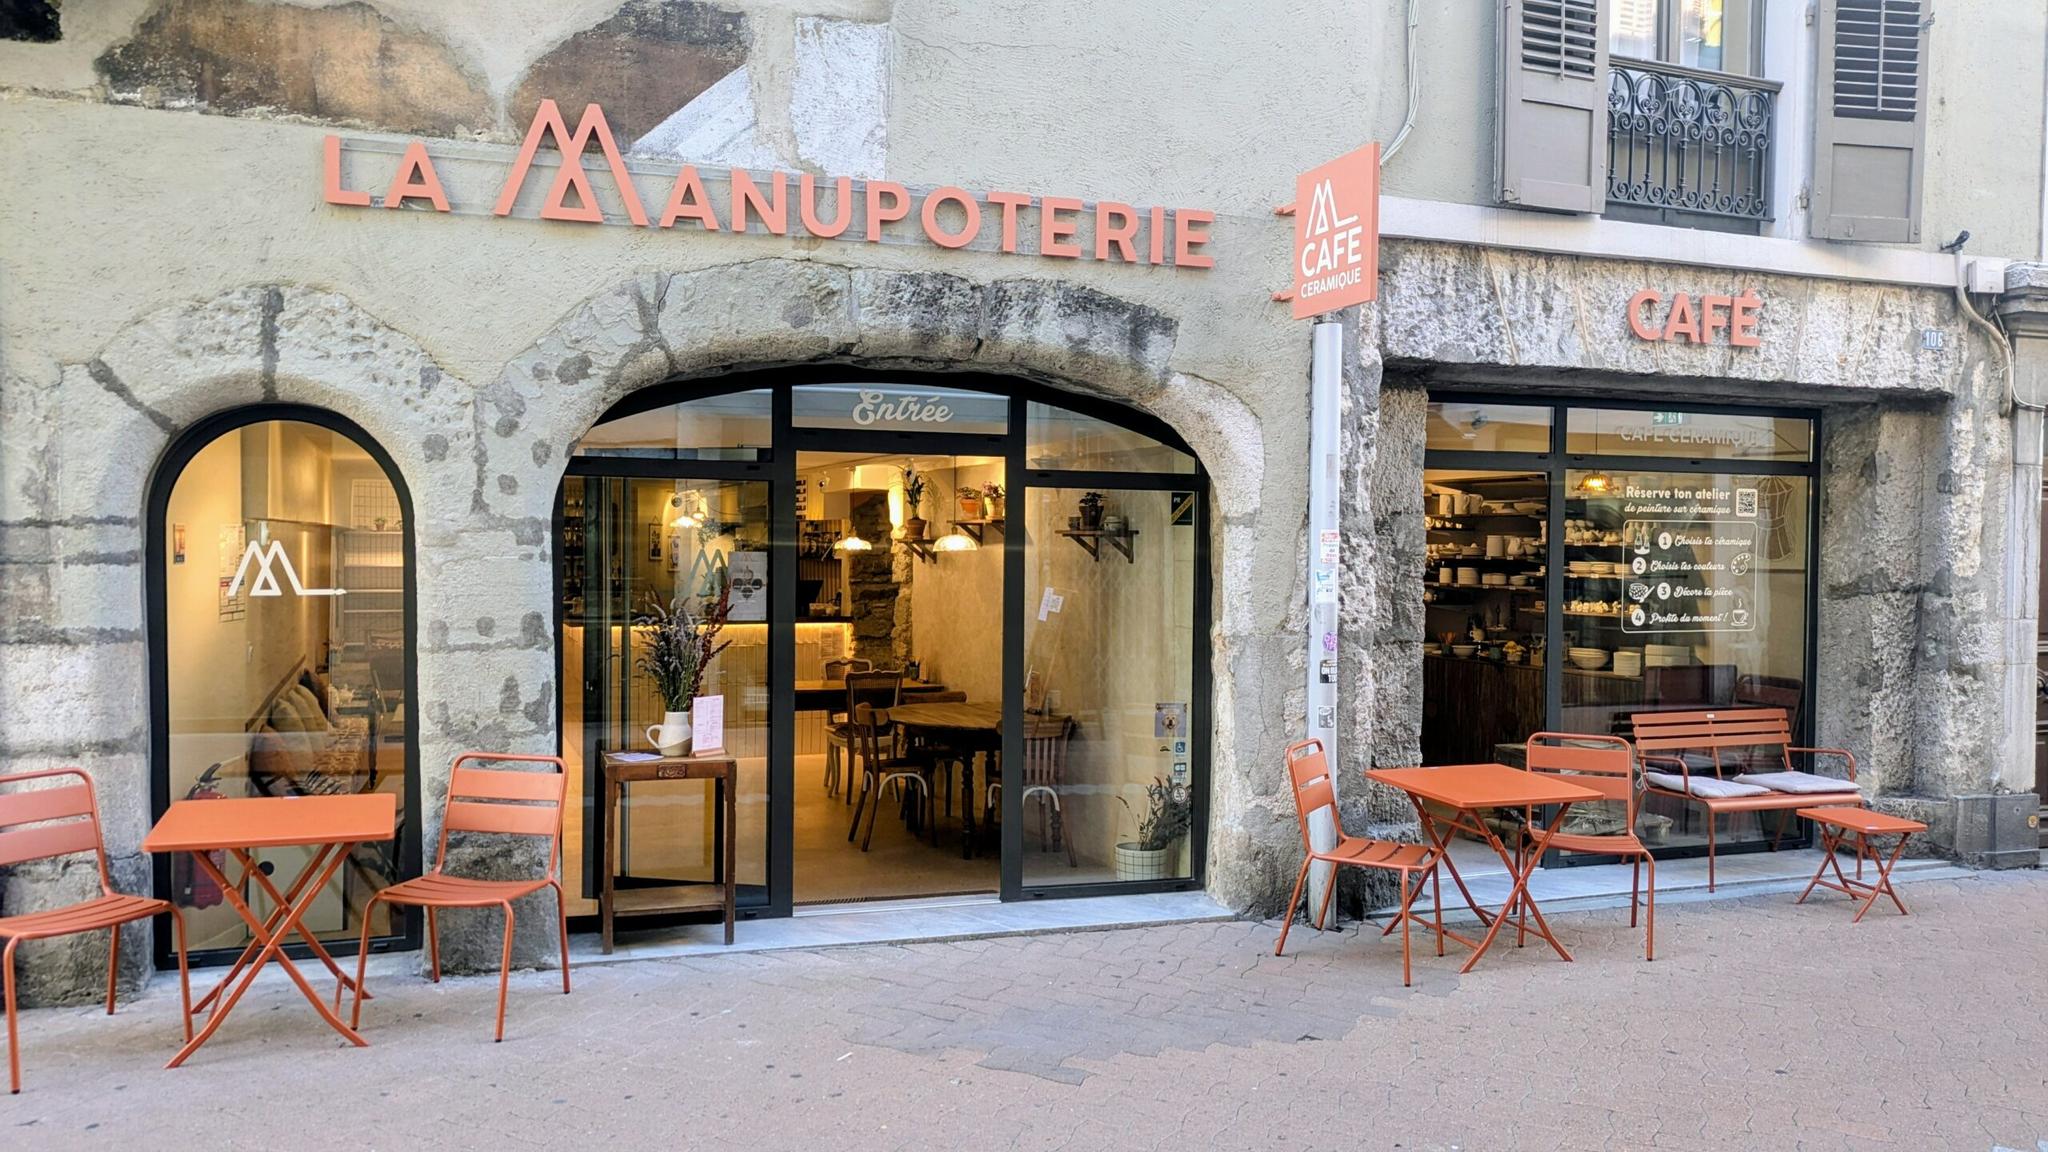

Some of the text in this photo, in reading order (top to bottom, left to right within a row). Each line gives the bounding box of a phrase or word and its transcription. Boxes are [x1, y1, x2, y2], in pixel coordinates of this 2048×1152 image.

[324, 98, 1215, 268] LA MANUPOTERIE
[1301, 225, 1363, 278] CAFE
[1300, 267, 1362, 298] CERAMIQUE
[1628, 287, 1761, 347] CAFÉ
[1925, 331, 1944, 347] 106
[852, 388, 954, 426] Entrée
[1625, 486, 1731, 500] Réserve ton atelier
[1624, 502, 1731, 515] de peinture sur céramique
[1674, 535, 1703, 547] Choisis
[1650, 560, 1679, 572] Choisis
[1680, 560, 1692, 571] tes
[1693, 561, 1726, 571] couleurs
[1673, 586, 1703, 598] Décore
[1704, 587, 1713, 596] ta
[1649, 612, 1679, 625] Profite
[1680, 613, 1691, 623] du
